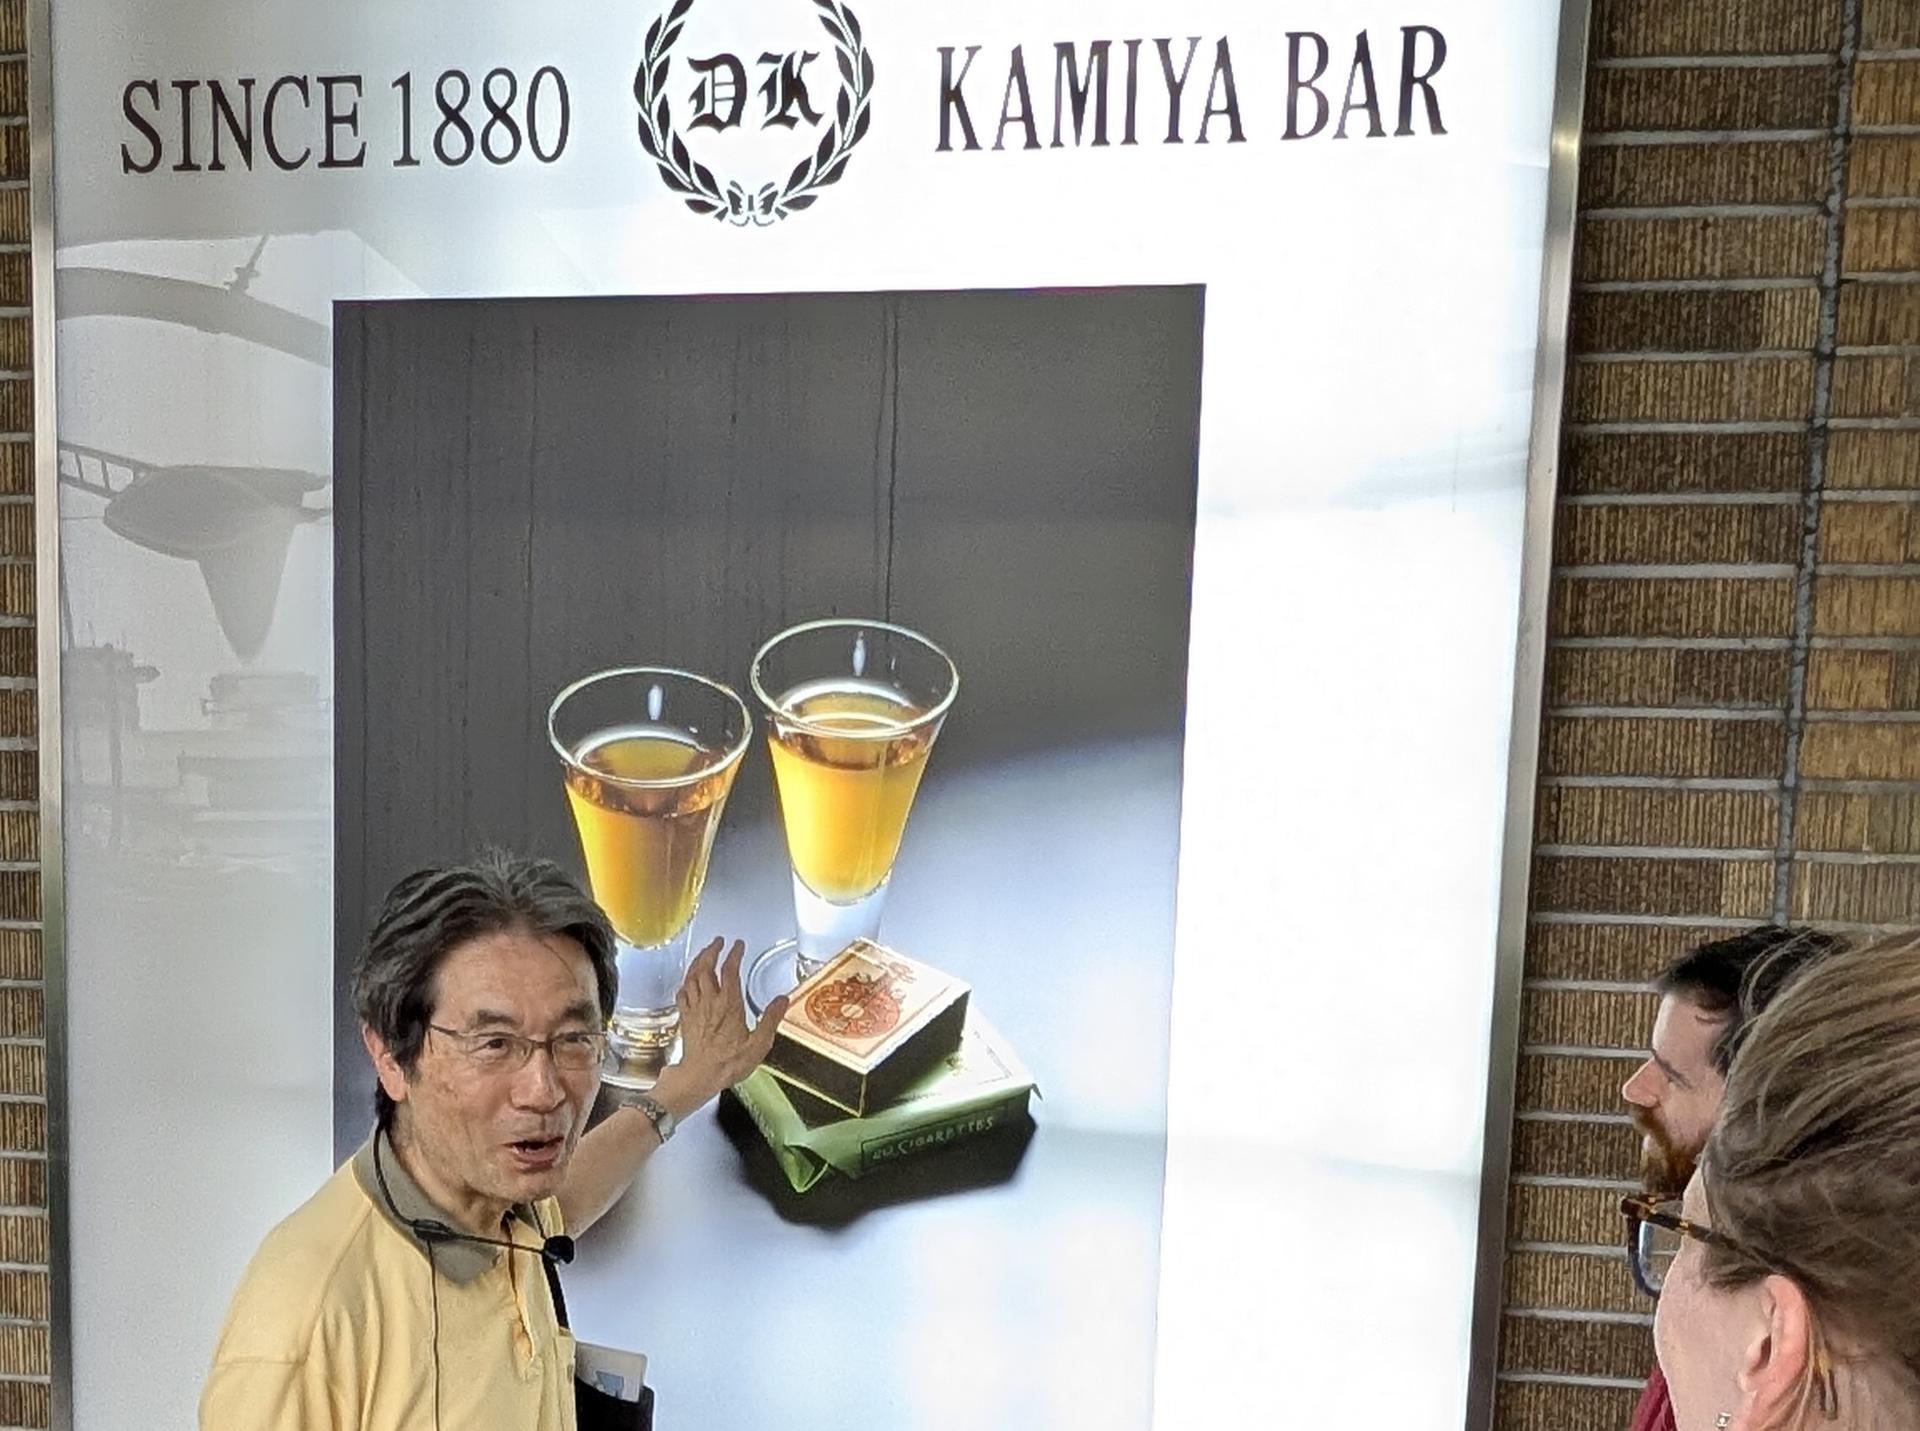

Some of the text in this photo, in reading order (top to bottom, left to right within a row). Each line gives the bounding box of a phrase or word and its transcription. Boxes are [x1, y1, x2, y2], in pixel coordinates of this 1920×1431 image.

[120, 66, 570, 175] SINCE 1880
[935, 25, 1448, 152] KAMIYA BAR
